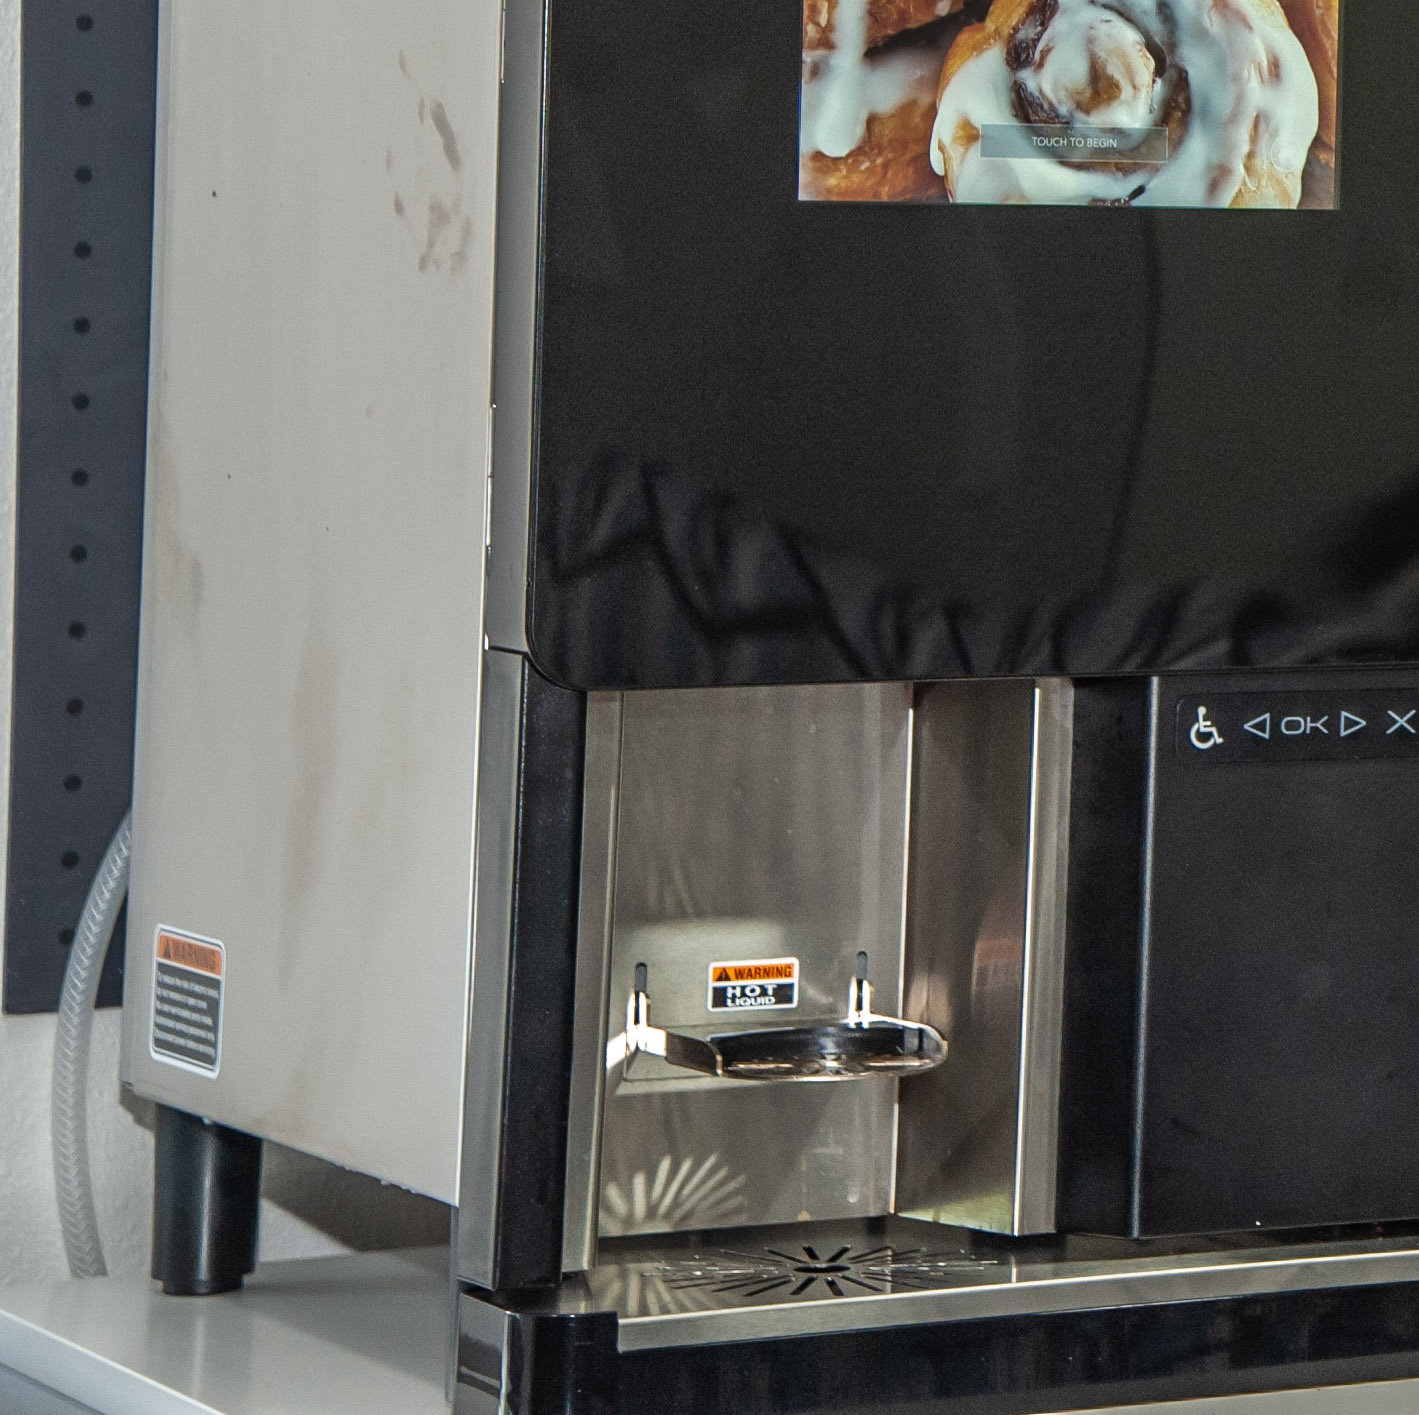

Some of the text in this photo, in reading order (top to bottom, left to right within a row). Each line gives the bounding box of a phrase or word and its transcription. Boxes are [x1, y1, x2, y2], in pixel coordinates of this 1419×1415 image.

[1031, 137, 1118, 148] TOUCH TO BEGIN
[1280, 715, 1329, 735] OK
[733, 965, 793, 980] WARNING
[727, 984, 777, 997] HOT
[727, 996, 775, 1007] LIQUID
